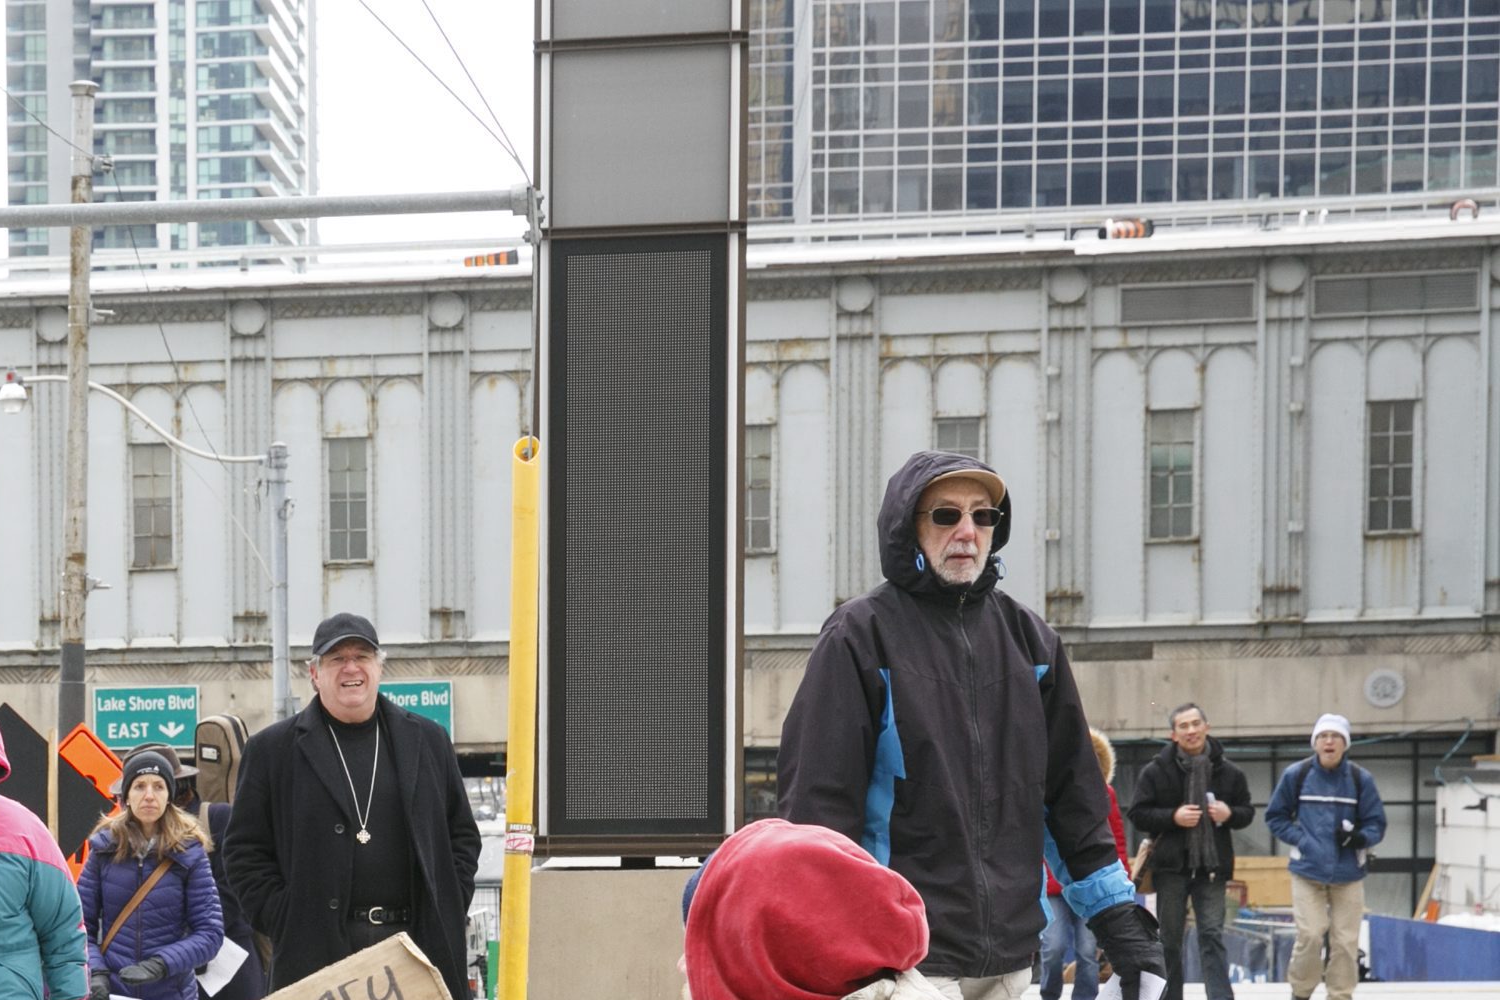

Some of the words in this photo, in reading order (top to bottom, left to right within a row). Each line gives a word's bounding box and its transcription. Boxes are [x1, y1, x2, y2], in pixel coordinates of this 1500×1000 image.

[97, 697, 126, 712] Lake
[129, 695, 166, 712] Shore
[168, 694, 196, 711] Blvd
[382, 691, 418, 707] hore
[421, 690, 449, 706] Blvd
[108, 722, 149, 739] EAST
